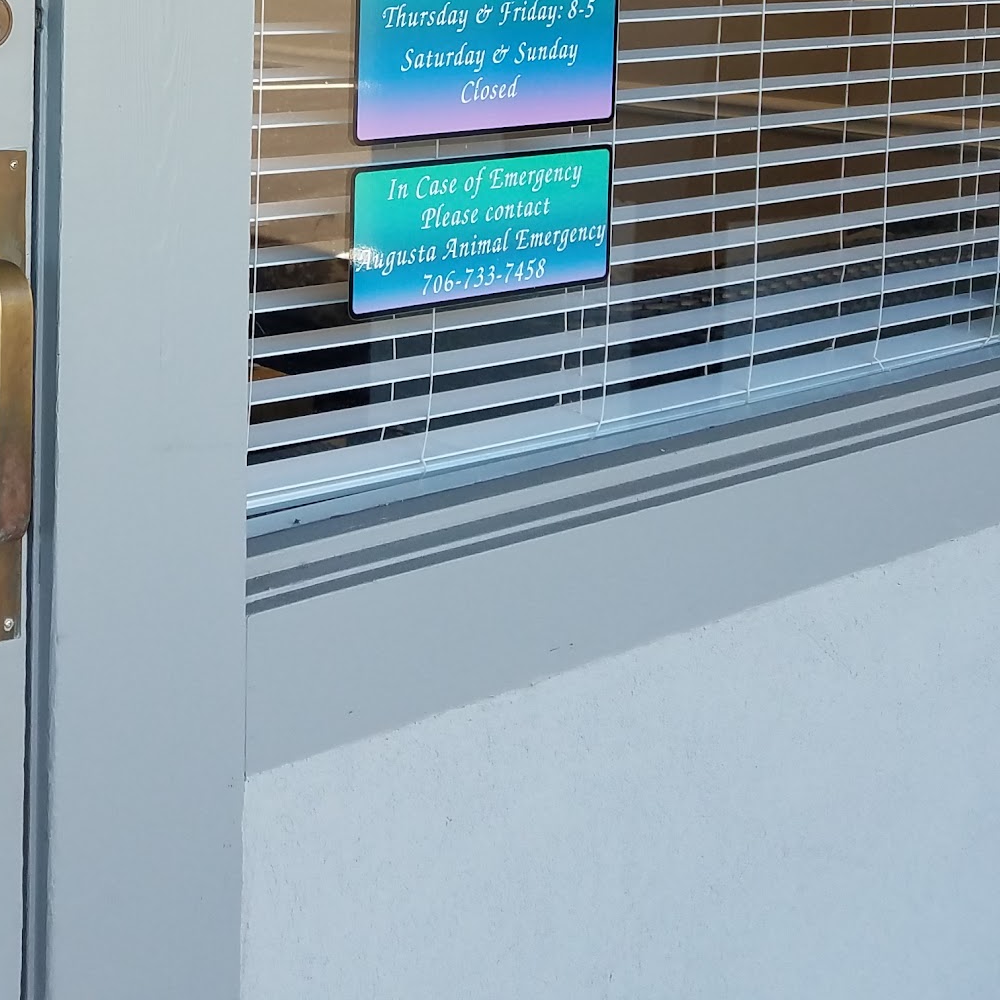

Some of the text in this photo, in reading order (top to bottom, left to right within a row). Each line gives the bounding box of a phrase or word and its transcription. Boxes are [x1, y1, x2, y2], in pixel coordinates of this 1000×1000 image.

[382, 1, 469, 32] Thursday
[475, 4, 494, 24] &
[499, 0, 563, 28] Friday:
[401, 36, 579, 73] Saturday & Sunday
[461, 74, 520, 104] Closed
[387, 163, 583, 201] In Case of Emergency
[420, 197, 551, 230] Please contact
[355, 223, 606, 276] Augusta Animal Emergency
[421, 258, 547, 296] 706-733-7458
